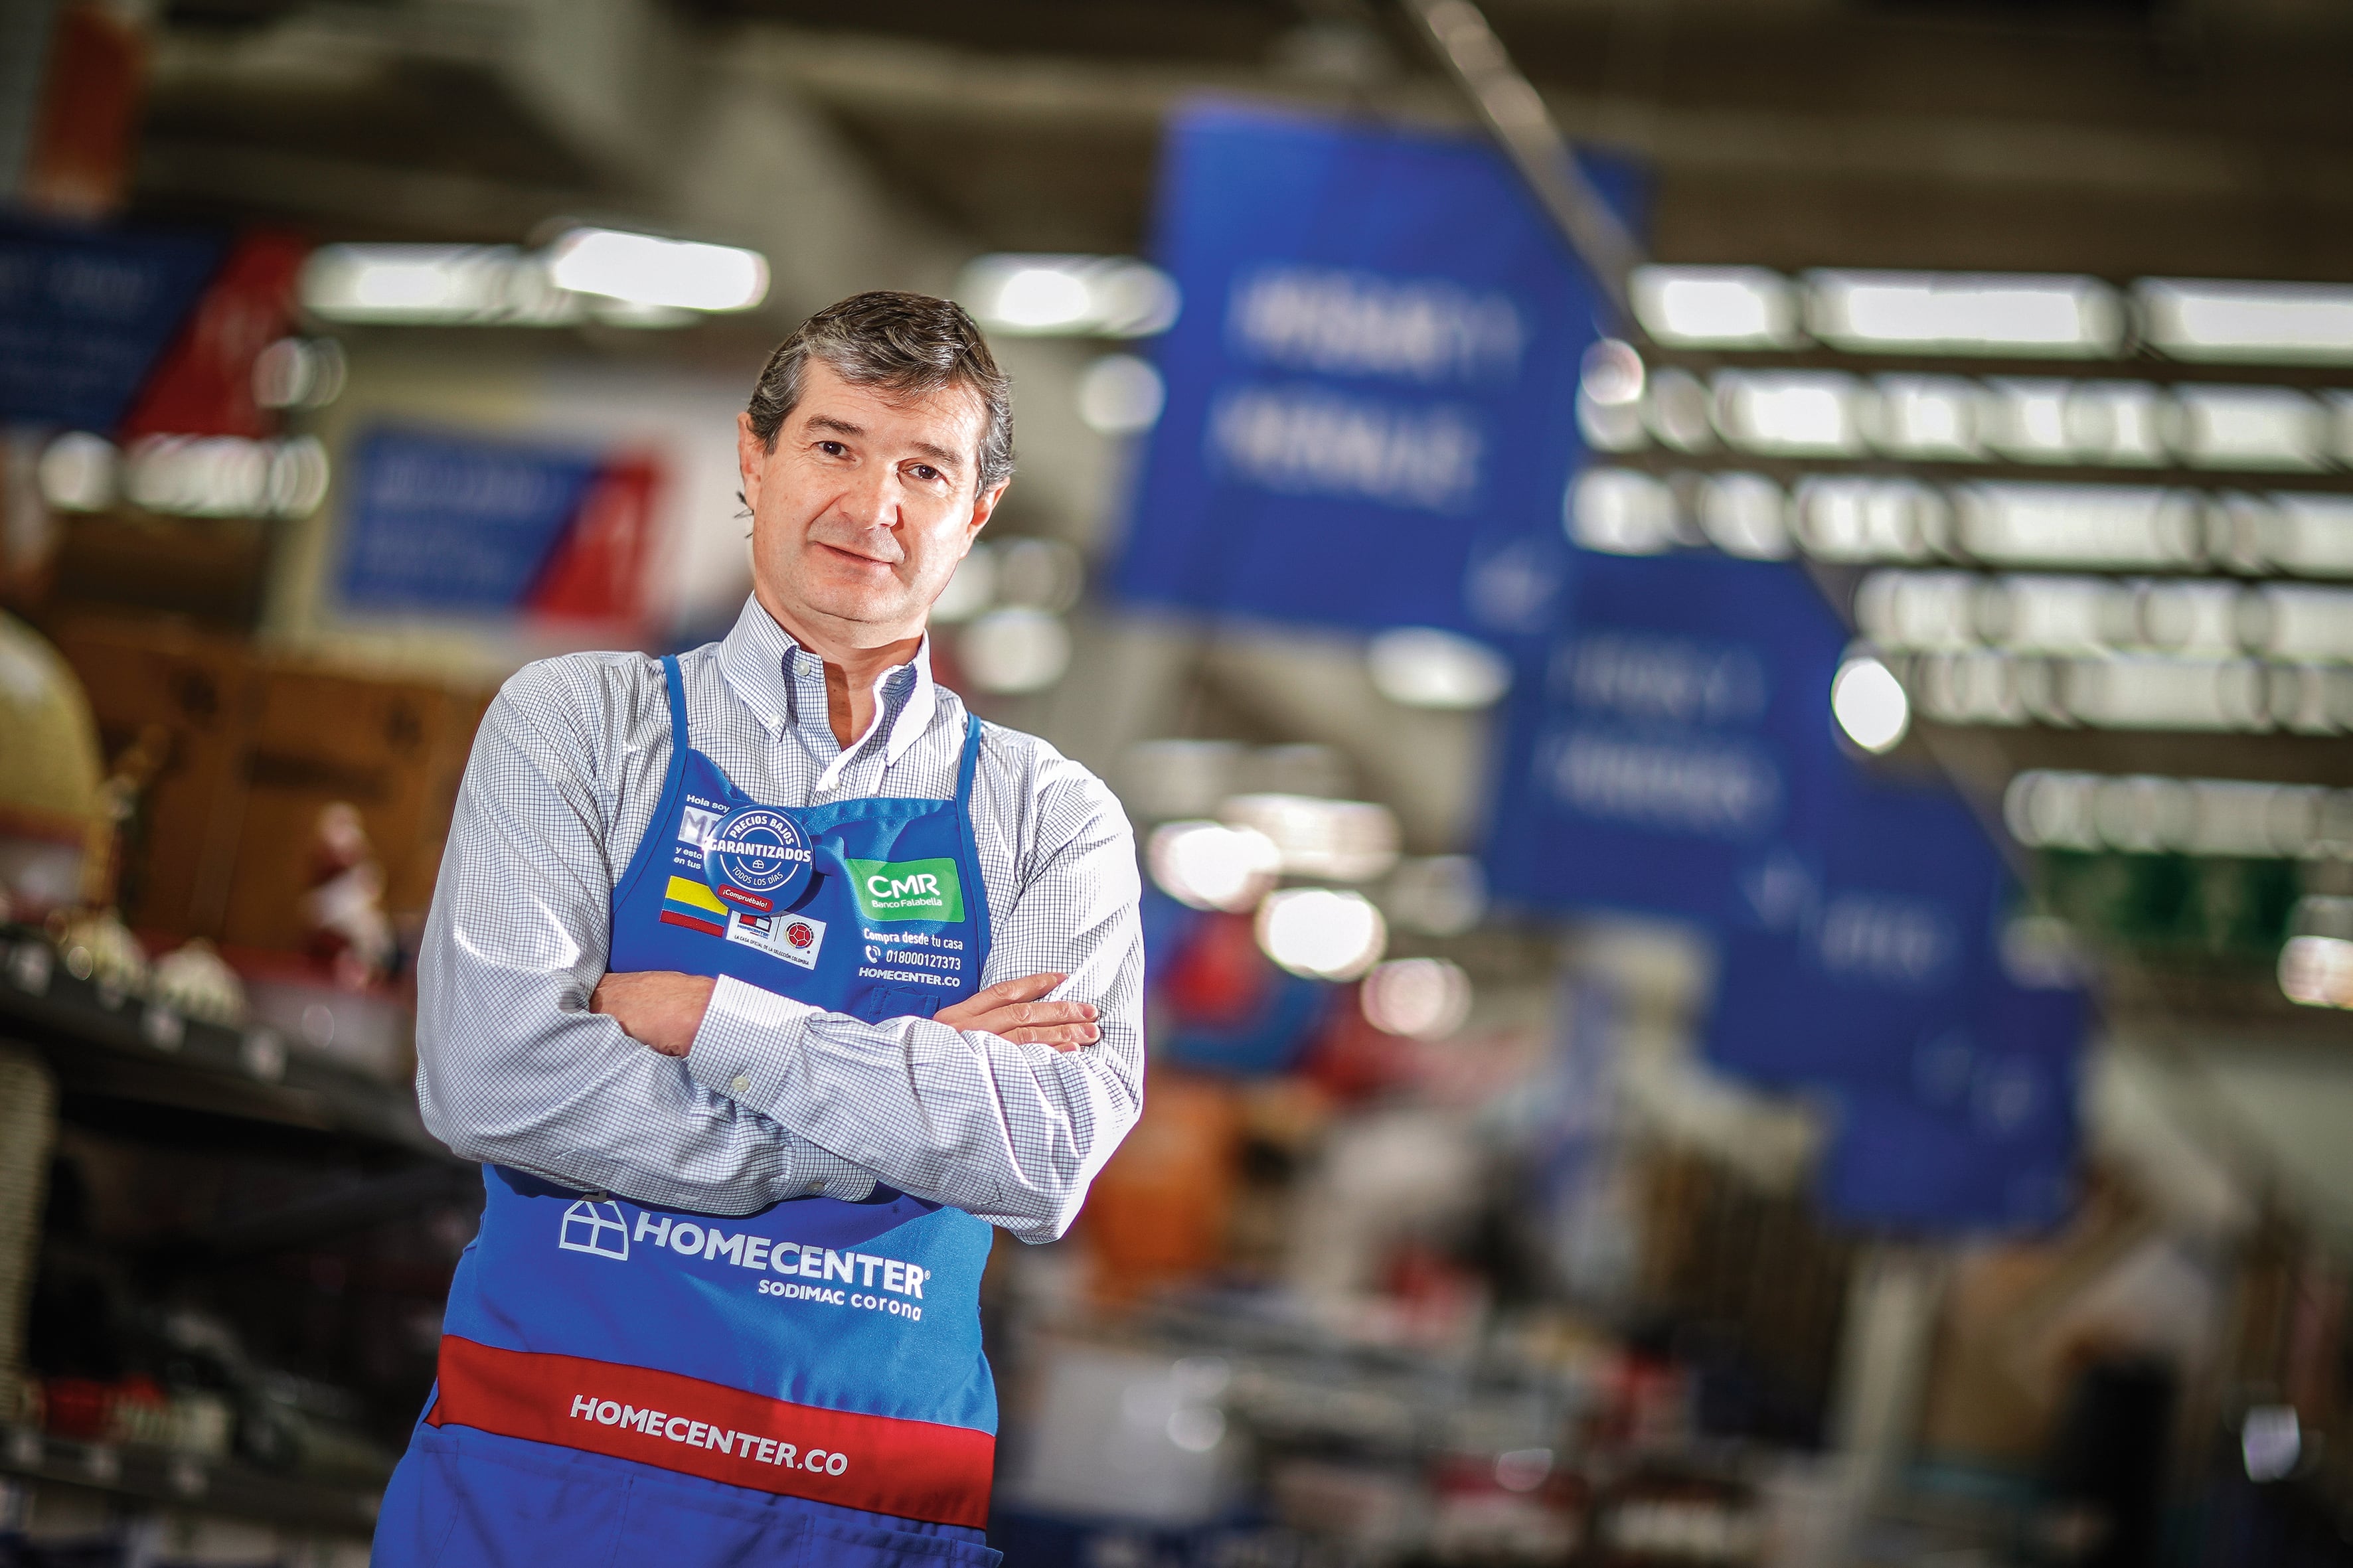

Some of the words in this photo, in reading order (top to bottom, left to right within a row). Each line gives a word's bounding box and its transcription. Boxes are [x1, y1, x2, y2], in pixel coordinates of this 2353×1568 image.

[687, 794, 710, 807] Hola
[712, 802, 730, 813] soy
[729, 815, 768, 838] PRECIOS
[769, 818, 795, 845] BAJOS
[708, 839, 812, 863] GARANTIZADOS
[673, 856, 685, 865] en
[687, 860, 702, 870] tus
[732, 866, 752, 884] TODOS
[768, 871, 784, 884] DÍAS
[867, 874, 941, 899] CMR
[722, 889, 768, 909] ¡Compruébalo!
[871, 900, 900, 908] Banco
[900, 898, 943, 907] Falabella
[864, 927, 900, 945] Compra
[902, 931, 930, 946] desde
[931, 934, 941, 948] tu
[943, 939, 963, 951] casa
[886, 949, 961, 971] 018000127373
[858, 967, 961, 988] HOMECENTER.CO
[758, 1279, 845, 1305] SODIMAC
[851, 1293, 922, 1321] corona
[570, 1394, 849, 1476] HOMECENTER.CO
